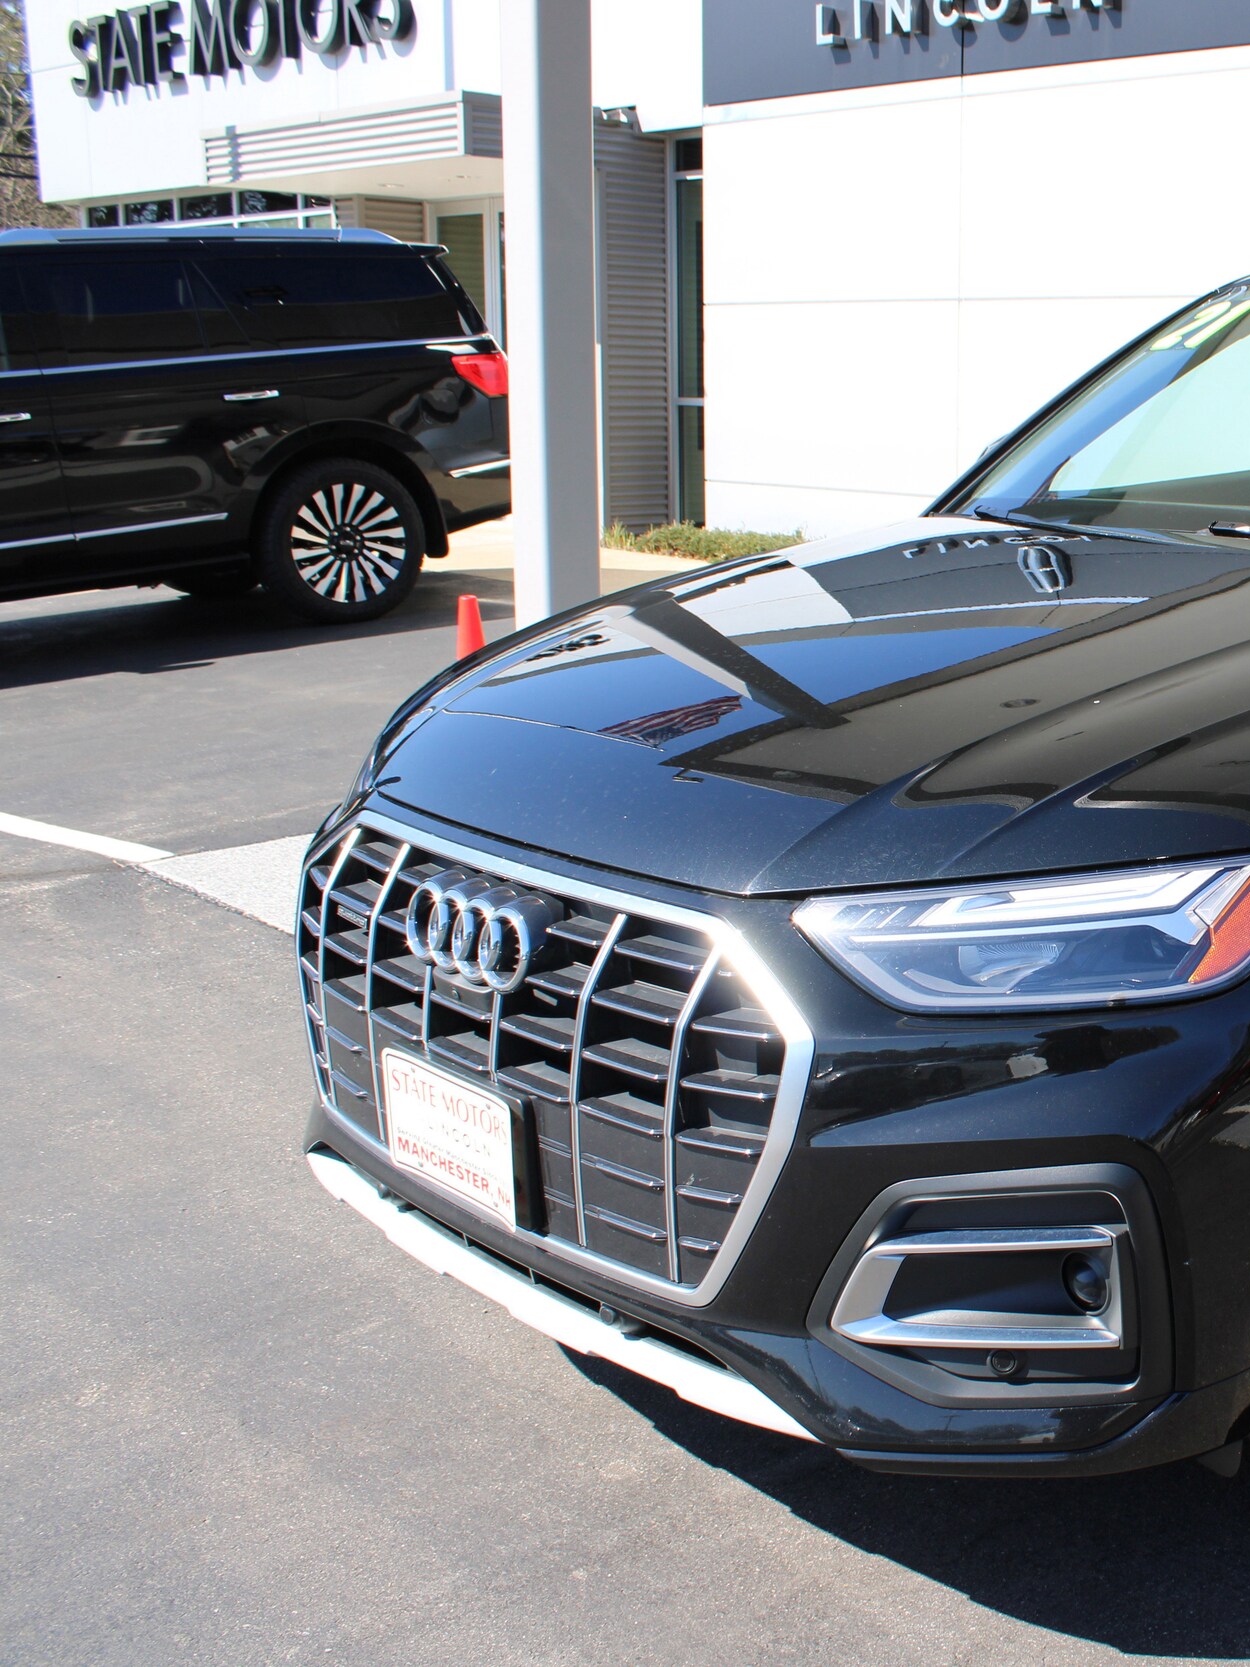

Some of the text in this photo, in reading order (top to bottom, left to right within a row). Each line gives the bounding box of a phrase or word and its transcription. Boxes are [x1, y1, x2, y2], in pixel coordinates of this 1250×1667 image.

[69, 2, 183, 98] STATE
[816, 0, 1108, 46] LINC
[391, 1068, 508, 1146] STATE MOTORS
[498, 1186, 512, 1210] NH
